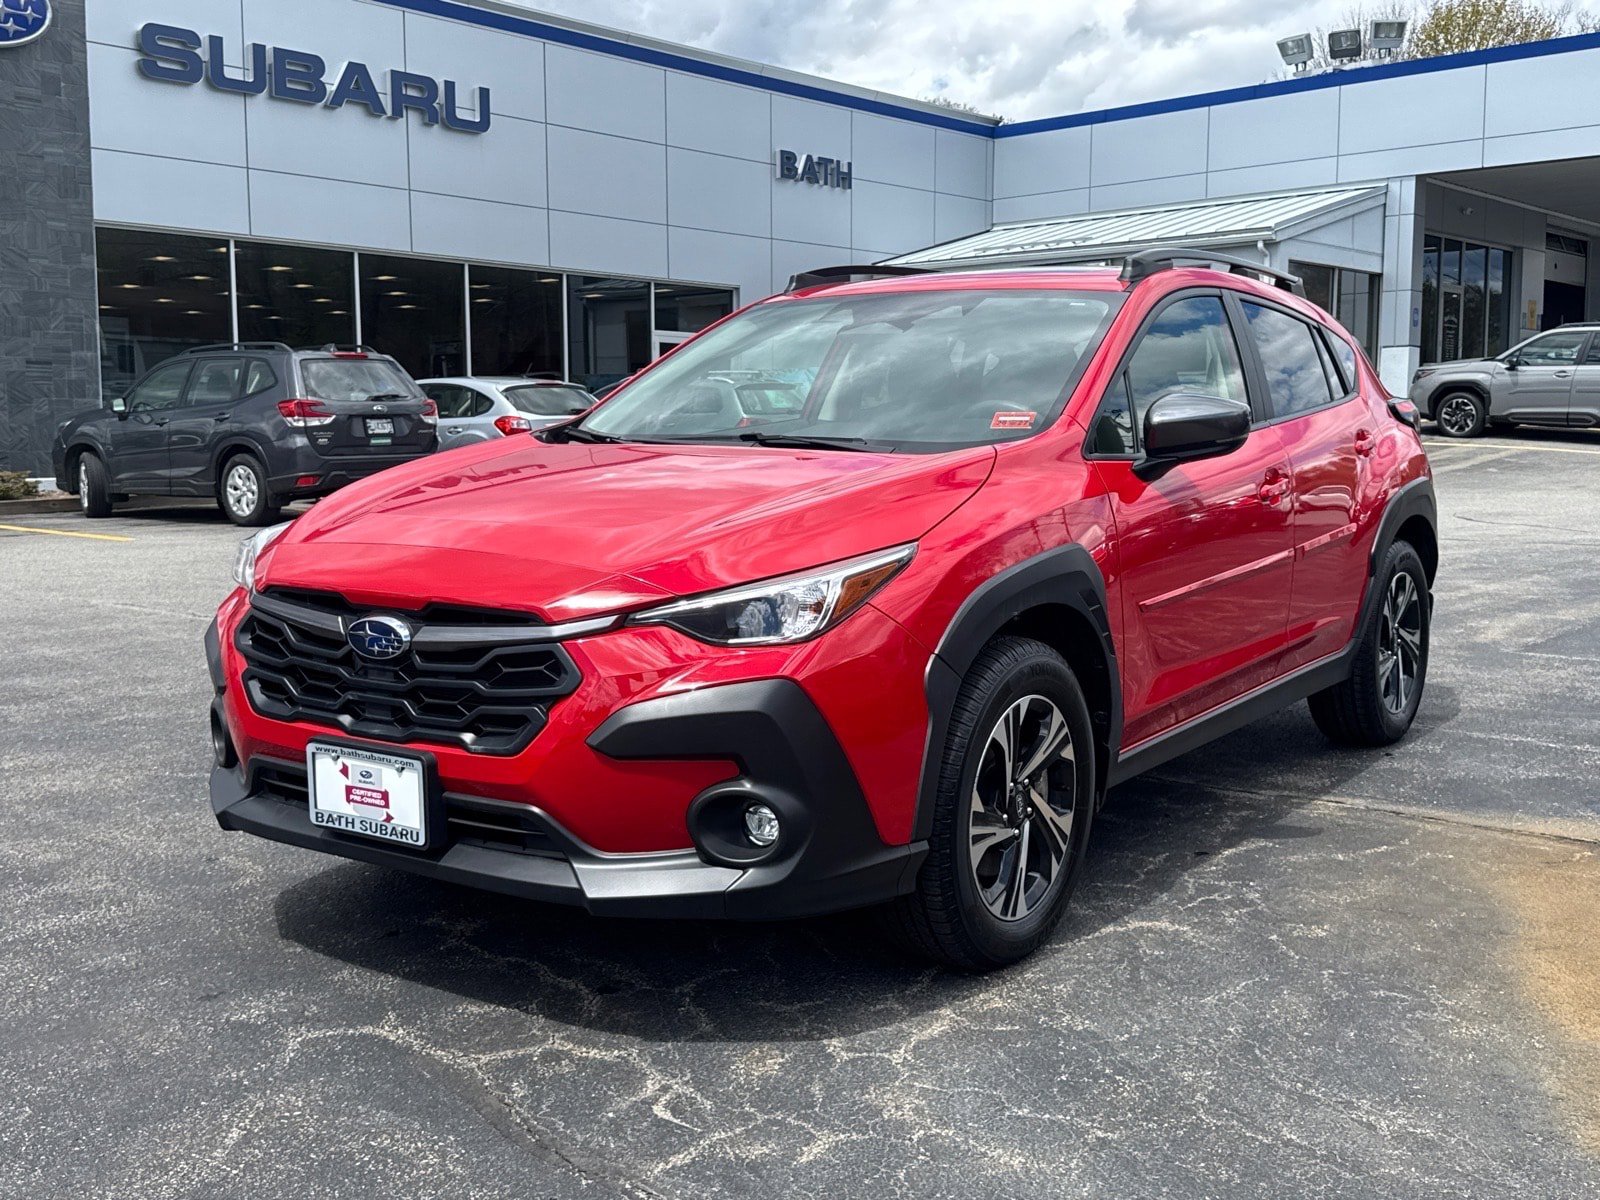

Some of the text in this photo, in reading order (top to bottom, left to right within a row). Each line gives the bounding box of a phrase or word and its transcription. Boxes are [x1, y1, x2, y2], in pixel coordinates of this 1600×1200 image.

[136, 22, 491, 134] SUBARU
[776, 149, 852, 189] BATH
[315, 745, 415, 769] www.bathsubaru.com
[350, 794, 386, 806] PRE-OWNED
[352, 788, 382, 799] CERTIFIED
[315, 811, 420, 843] BATH SUBARU
